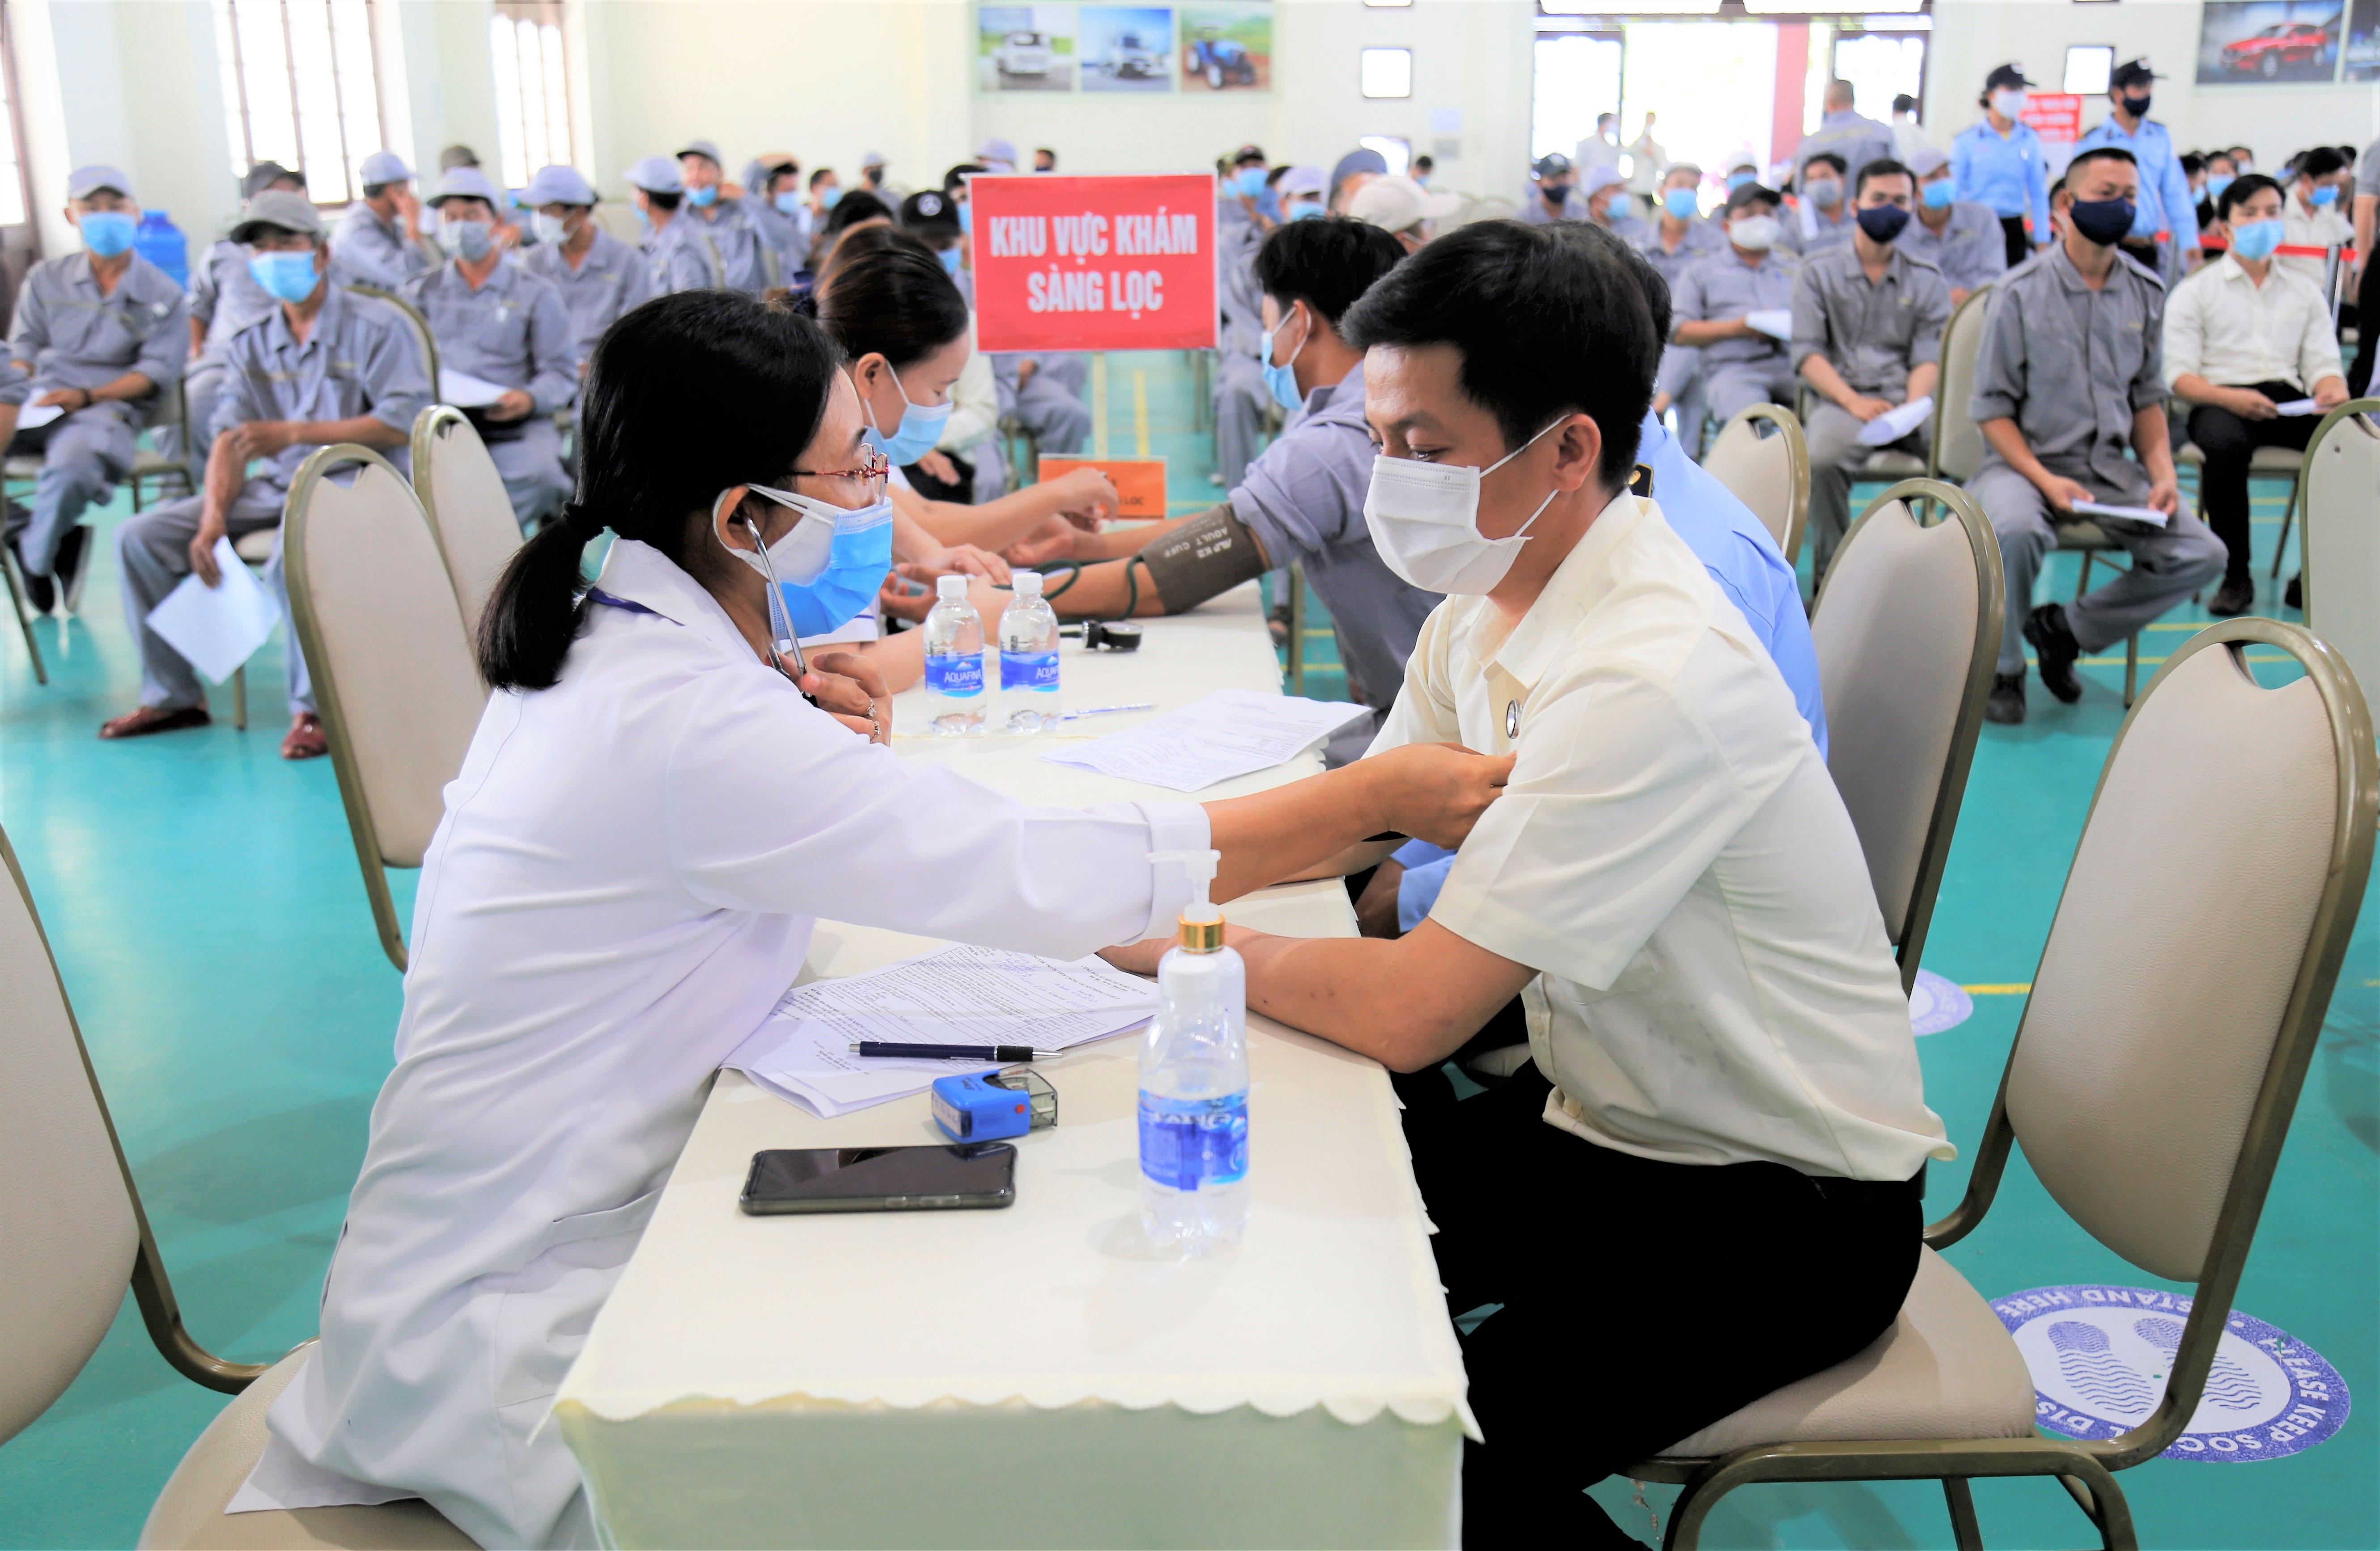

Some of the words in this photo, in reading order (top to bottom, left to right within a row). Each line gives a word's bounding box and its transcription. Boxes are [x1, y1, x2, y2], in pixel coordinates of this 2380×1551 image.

[989, 216, 1047, 257] KHU
[1053, 211, 1108, 265] VỰC
[1115, 205, 1198, 255] KHÁM
[1027, 263, 1104, 313] SÀNG
[1111, 270, 1163, 320] LỌC
[944, 668, 983, 684] AQUAFINA
[1035, 666, 1059, 680] AQUAF
[1996, 1290, 2072, 1317] HERE
[2081, 1289, 2193, 1313] STAND
[2269, 1403, 2326, 1442] KEEP
